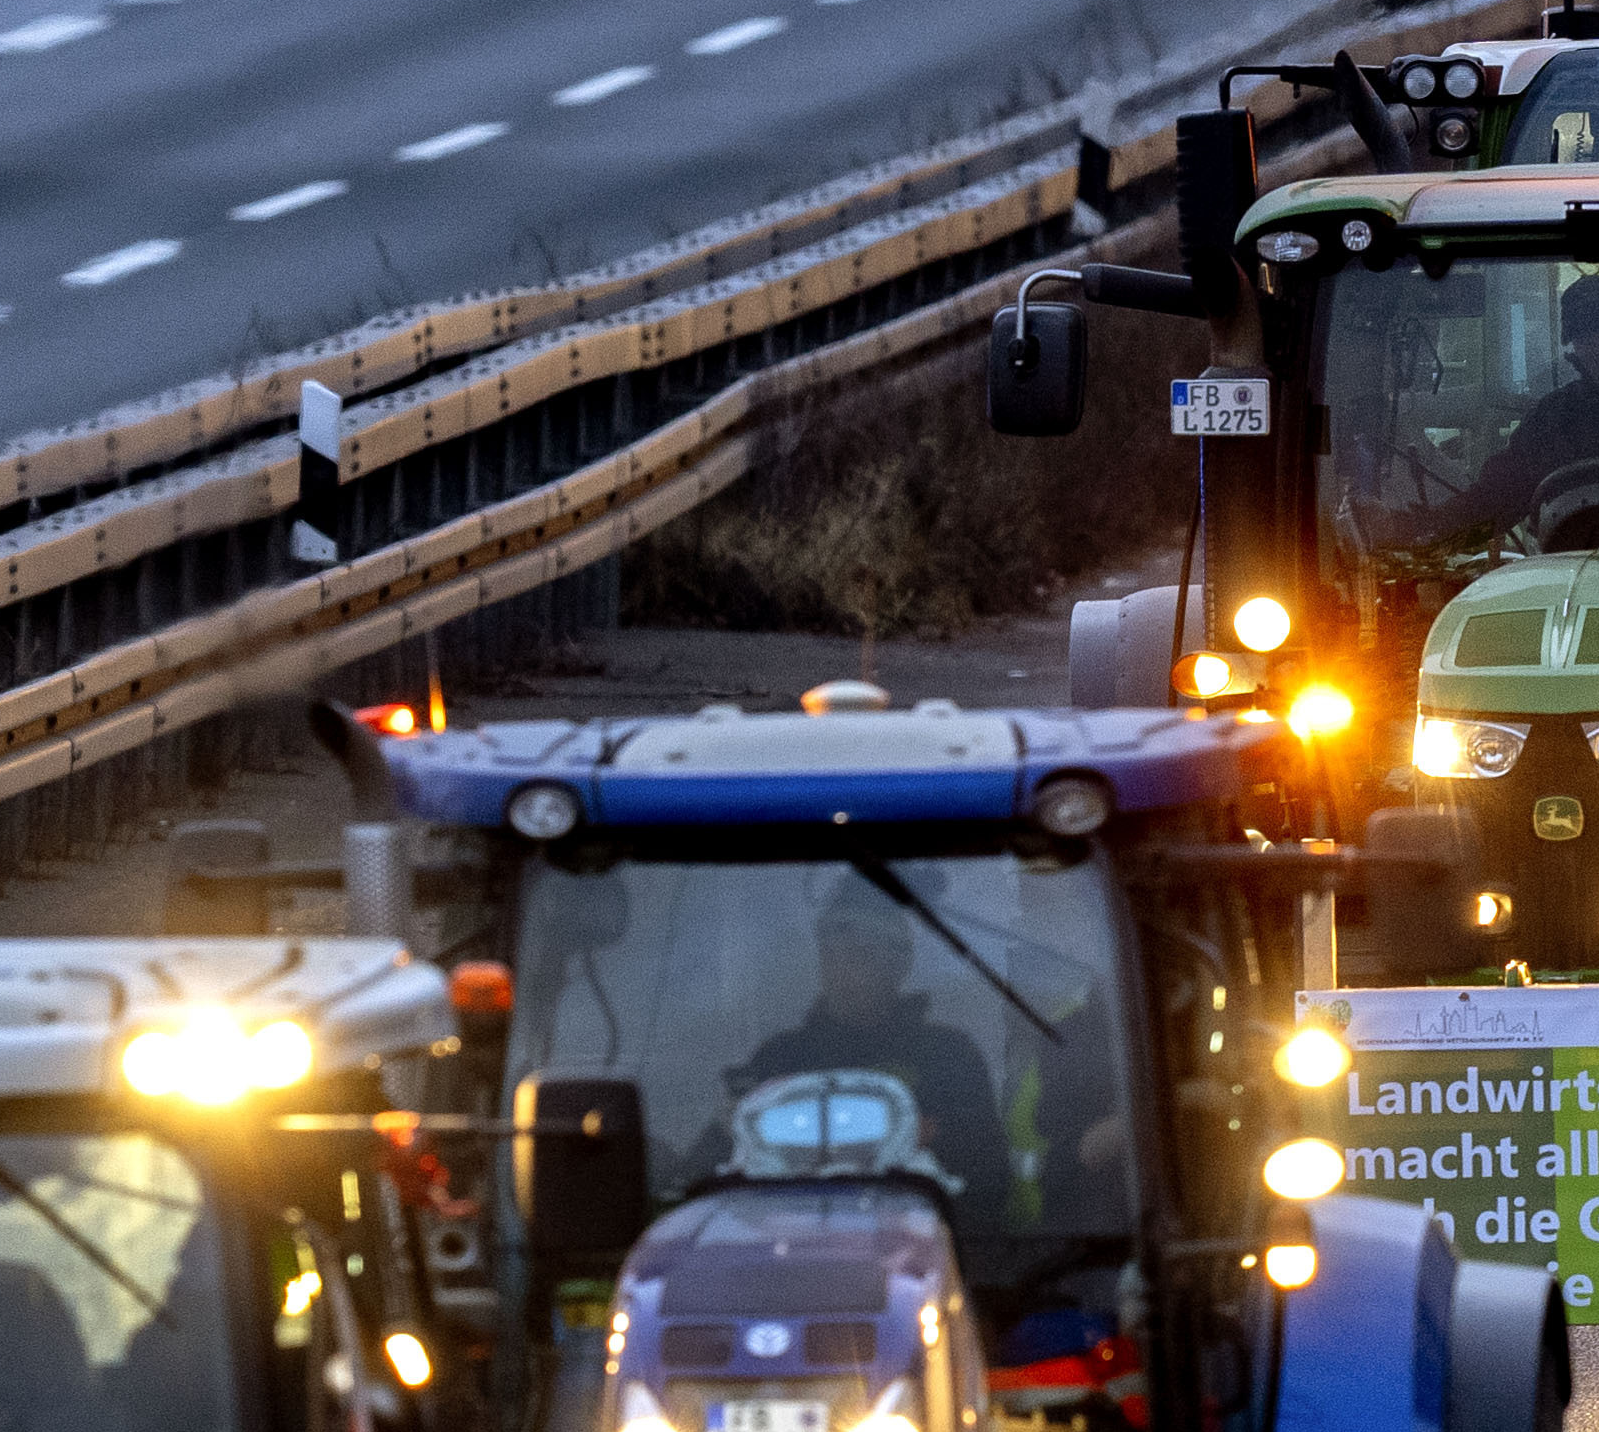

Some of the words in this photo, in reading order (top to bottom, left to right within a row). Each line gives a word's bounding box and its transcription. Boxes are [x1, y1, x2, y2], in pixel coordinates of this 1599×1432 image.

[1190, 384, 1220, 407] FB
[1183, 409, 1198, 432] L
[1203, 407, 1263, 432] 1275
[1344, 1132, 1519, 1181] macht
[1474, 1195, 1561, 1245] die
